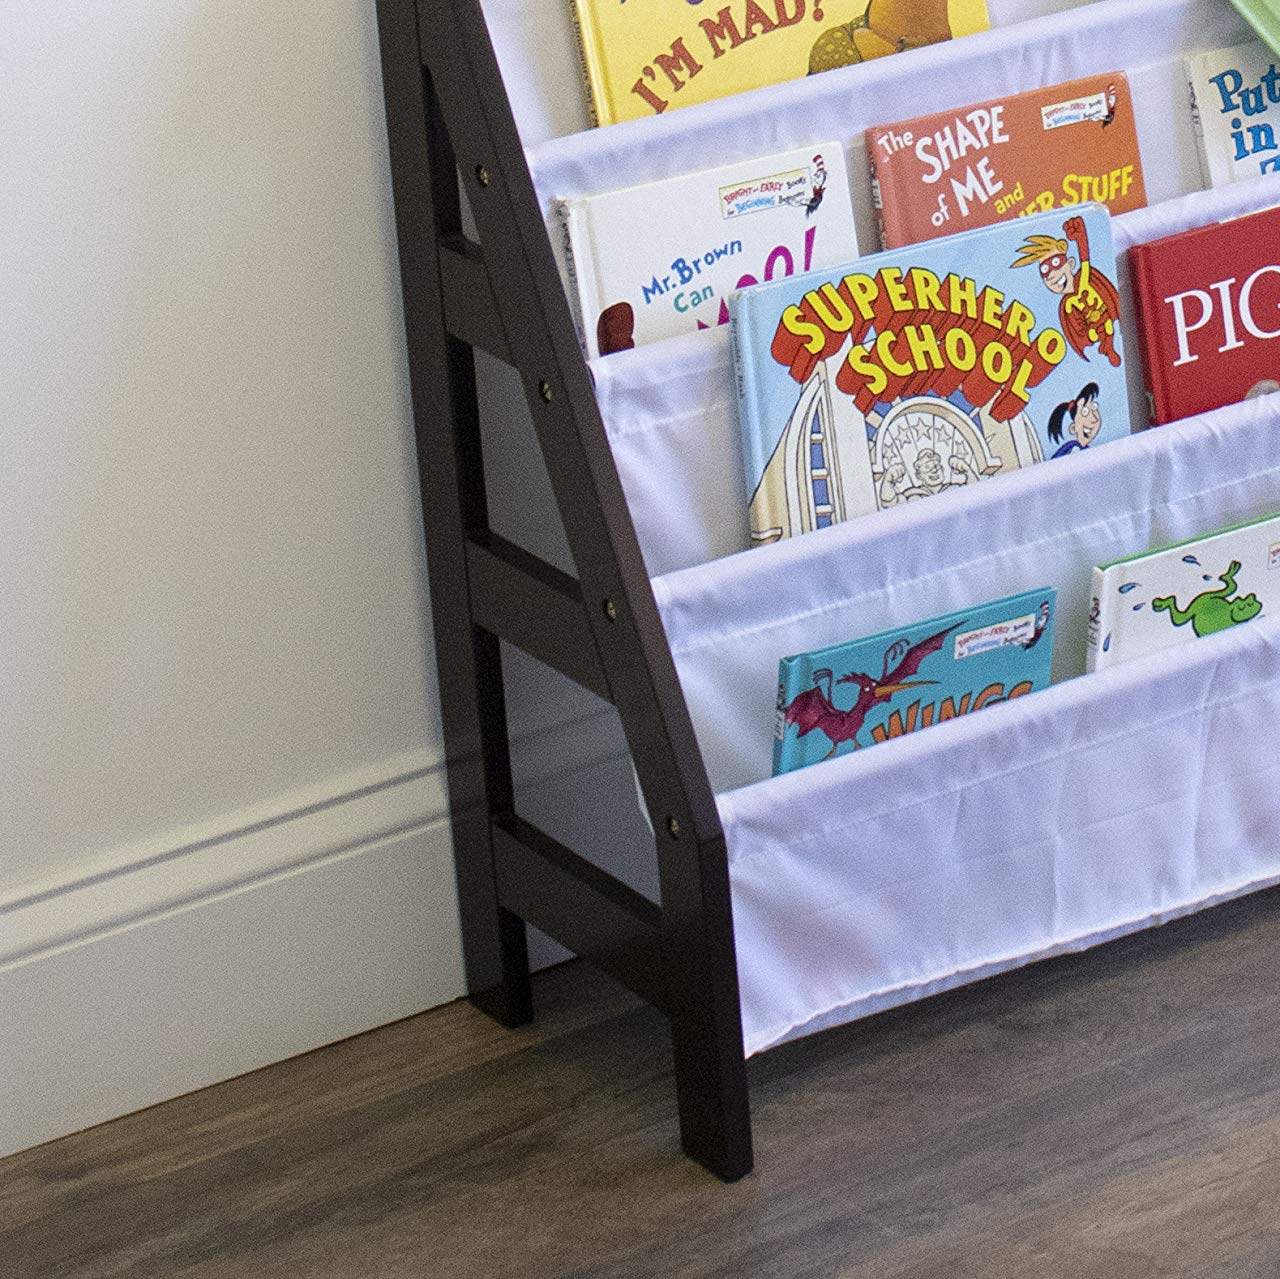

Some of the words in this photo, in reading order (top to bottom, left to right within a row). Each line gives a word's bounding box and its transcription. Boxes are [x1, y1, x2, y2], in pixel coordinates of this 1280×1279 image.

[631, 36, 704, 114] I'M
[878, 128, 914, 156] The
[914, 105, 1010, 185] SHAPE
[1230, 118, 1278, 161] in
[931, 193, 950, 227] of
[950, 156, 1003, 218] ME
[994, 181, 1024, 215] and
[1060, 164, 1134, 208] STUFF
[673, 284, 714, 314] Can
[782, 267, 1066, 366] SUPERHERO
[848, 323, 1034, 402] SCHOOL
